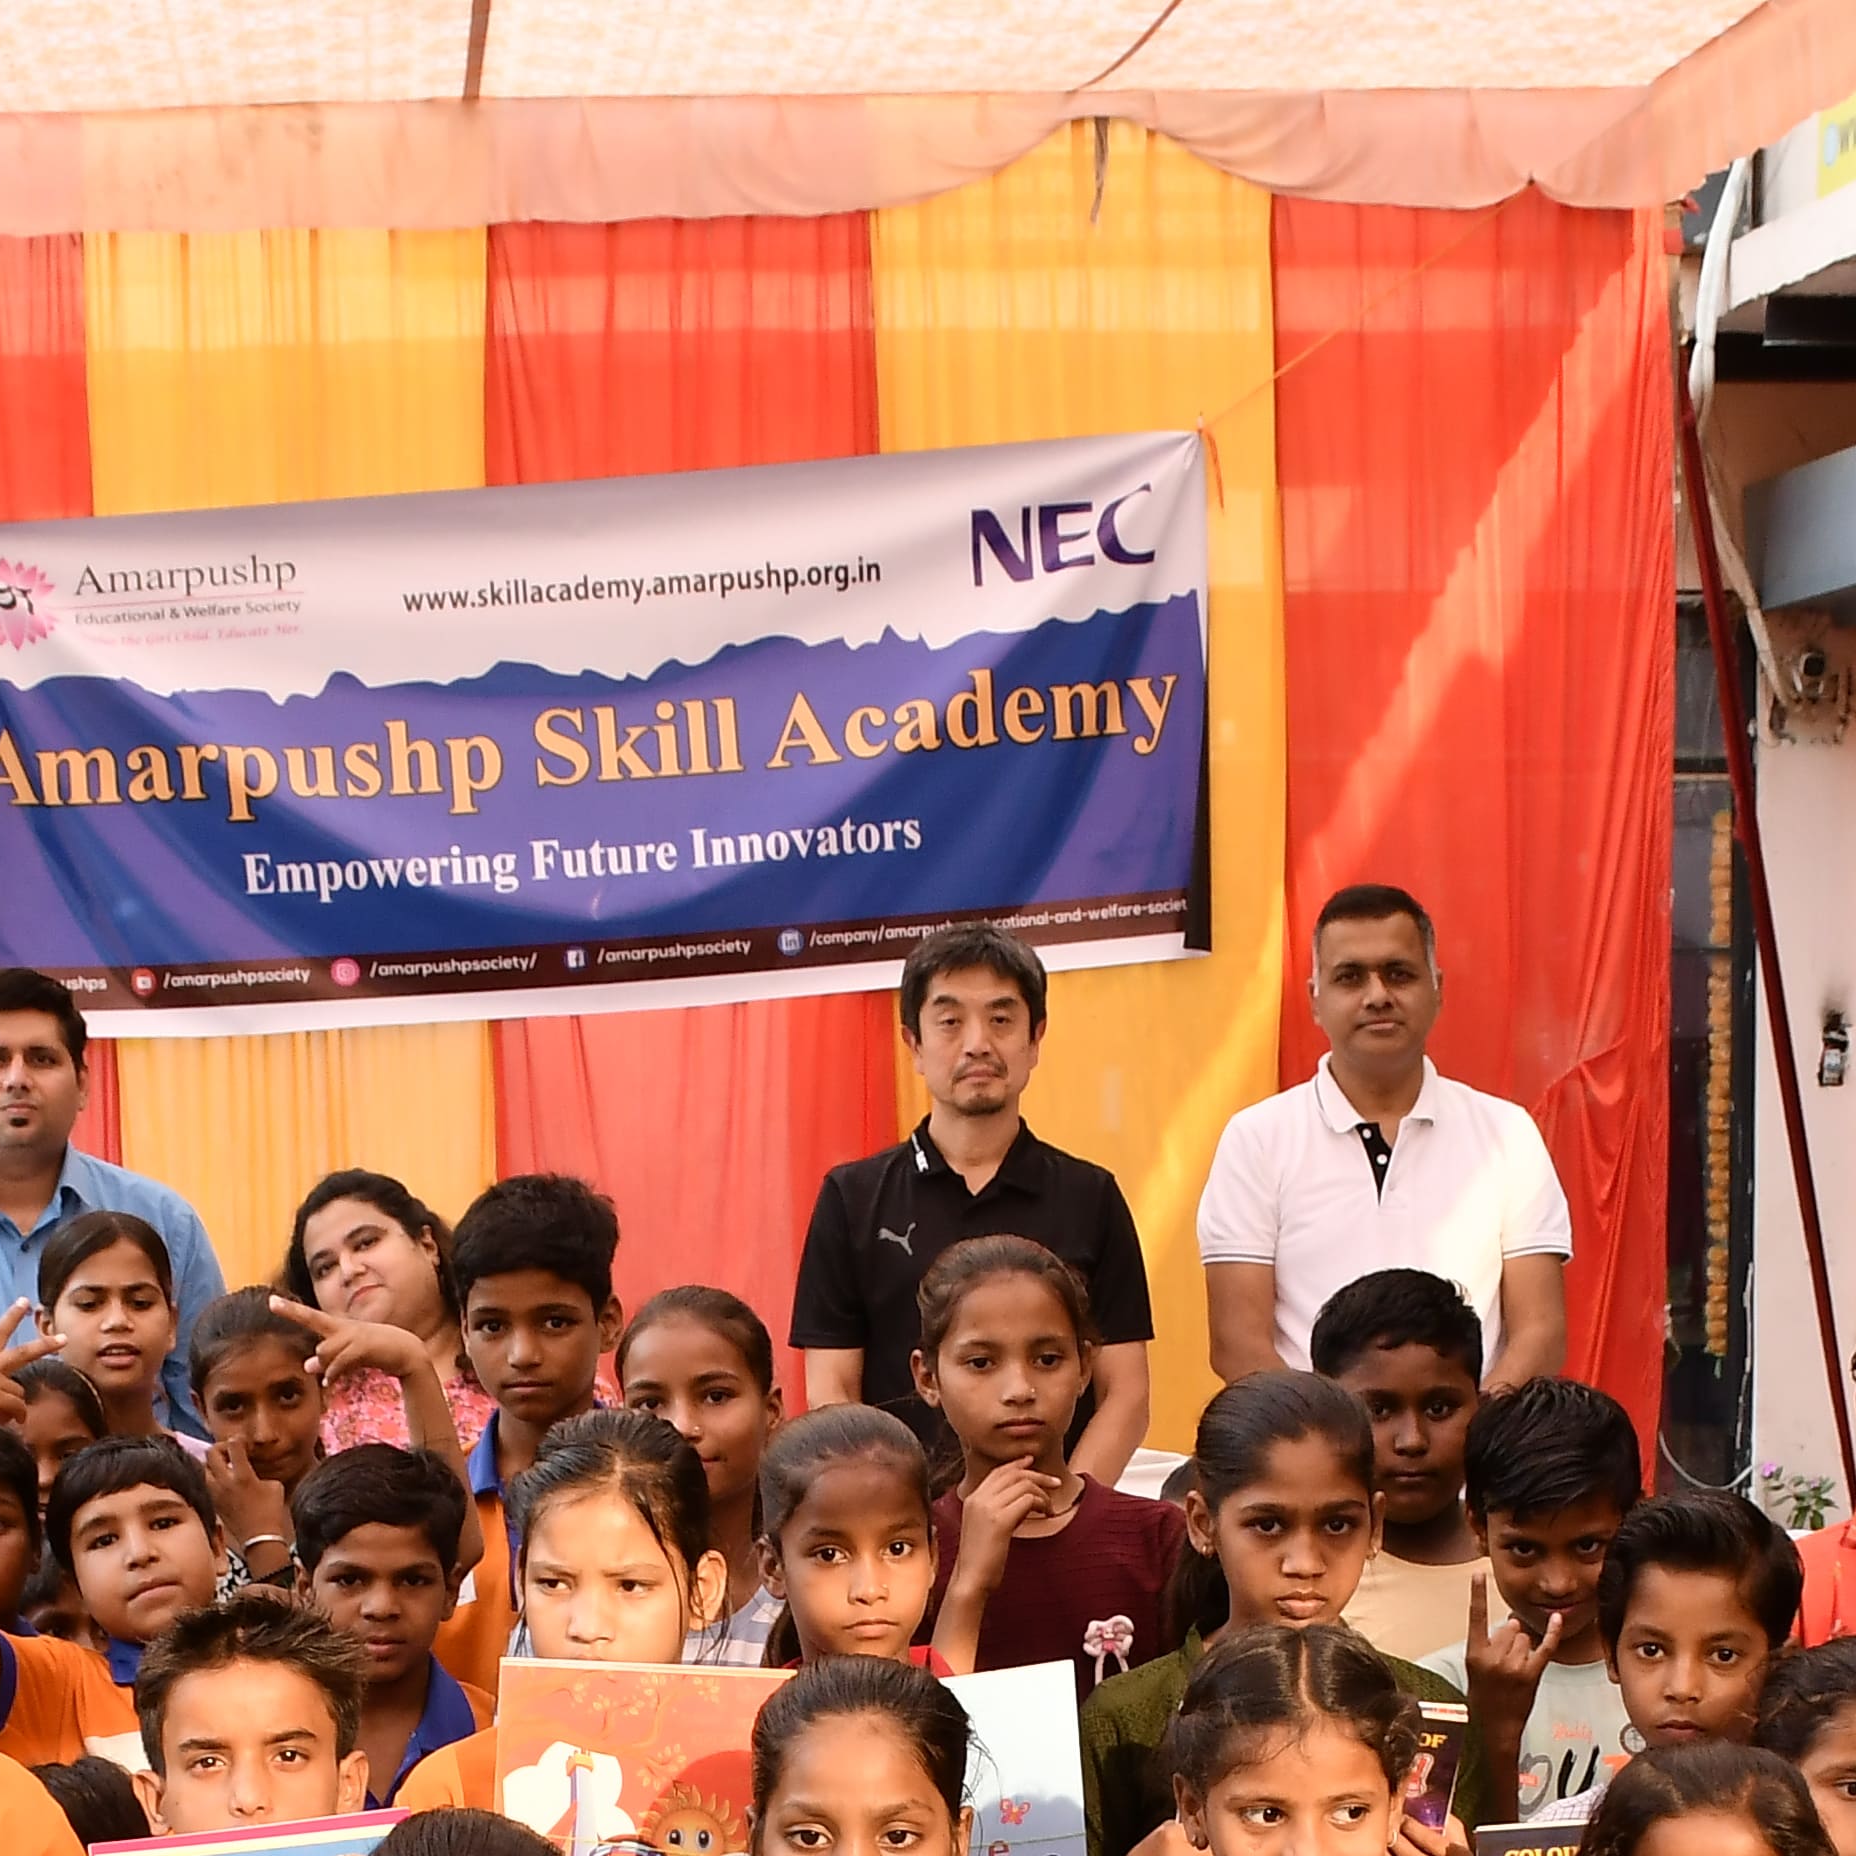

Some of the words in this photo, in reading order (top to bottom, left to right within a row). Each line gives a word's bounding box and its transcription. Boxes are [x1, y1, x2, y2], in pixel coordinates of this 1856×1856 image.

[970, 484, 1155, 588] NEC
[74, 555, 297, 597] Amarpushp
[403, 556, 882, 613] www.skillacademy.amarpushp.org.in
[75, 607, 166, 626] Educational
[170, 607, 181, 620] &
[184, 602, 242, 619] Welfare
[246, 598, 302, 616] Society
[534, 696, 744, 787] Skill
[766, 668, 1178, 757] Academy
[244, 843, 518, 902] Empowering
[530, 836, 677, 881] Future
[690, 815, 922, 869] Innovators
[164, 965, 311, 989] /amarpushpsociety
[369, 952, 538, 979] /amarpushpsociety/
[597, 936, 751, 964] /amarpushpsociety
